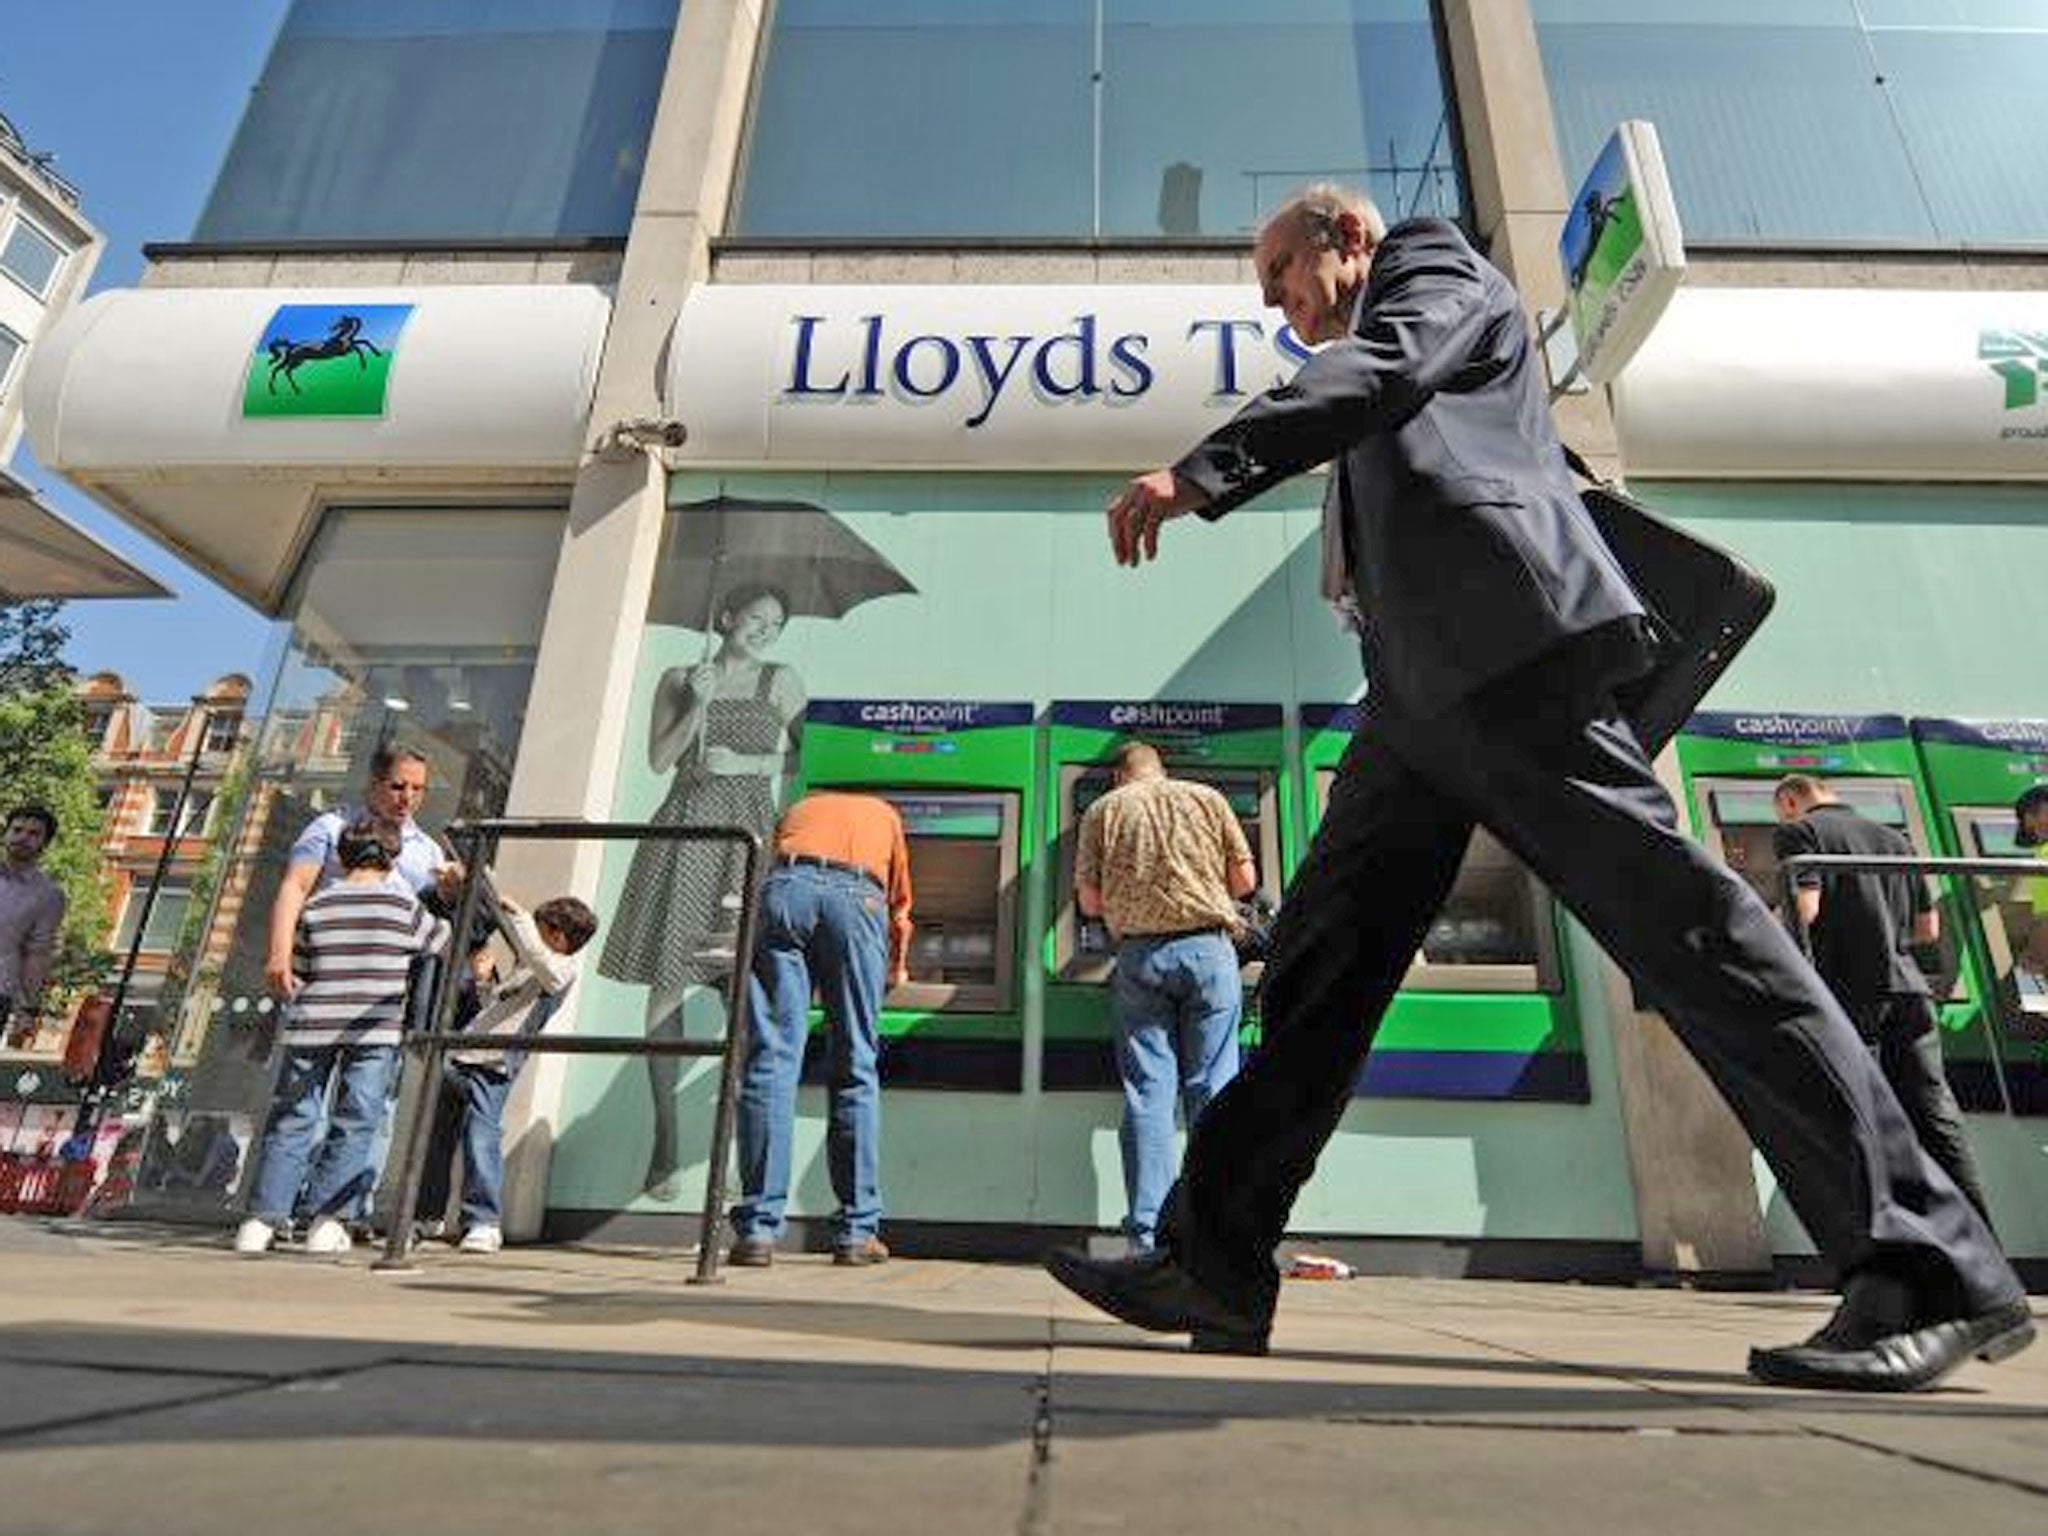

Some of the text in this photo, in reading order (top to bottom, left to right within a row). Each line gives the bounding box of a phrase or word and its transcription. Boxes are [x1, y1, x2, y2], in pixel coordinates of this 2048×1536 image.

[784, 313, 1312, 428] Lloyds TS
[860, 702, 974, 726] cashpoint
[1109, 702, 1224, 726] cashpoint
[1735, 715, 1857, 739] cashpoint
